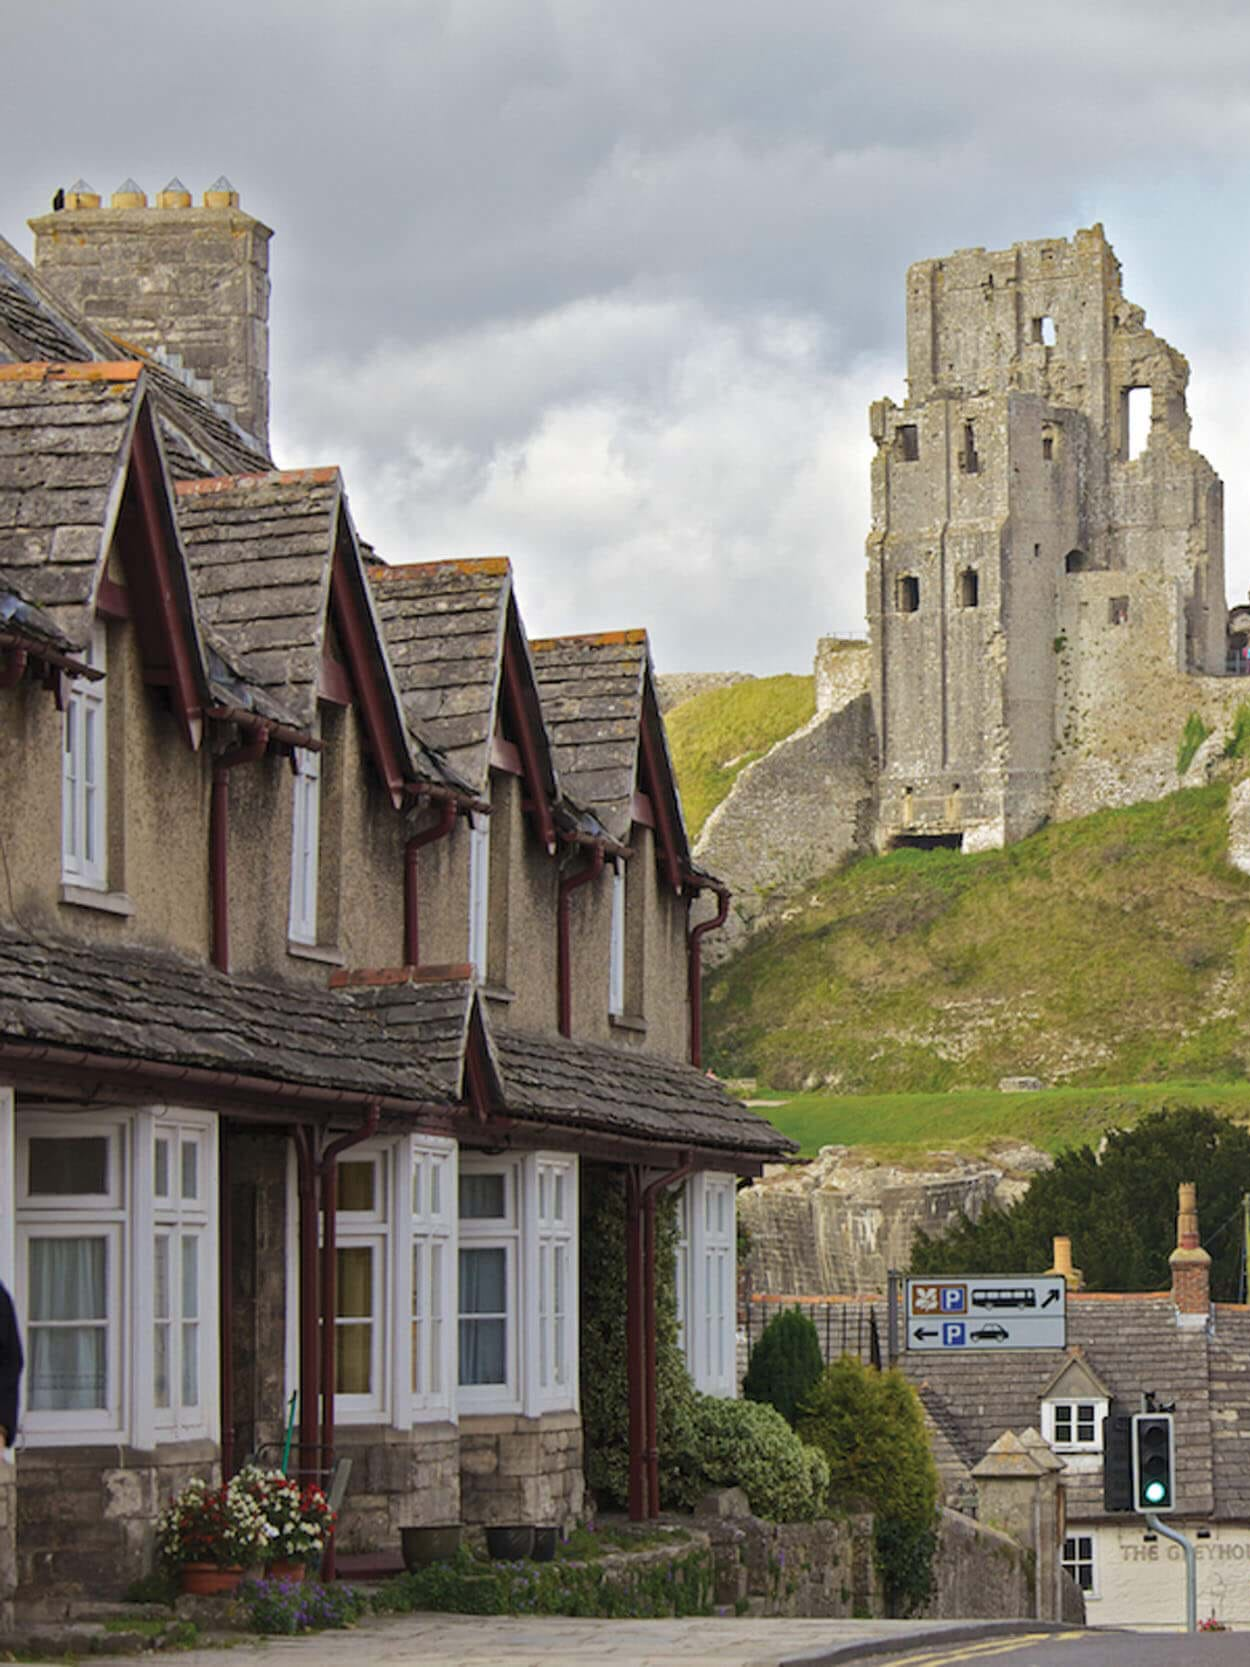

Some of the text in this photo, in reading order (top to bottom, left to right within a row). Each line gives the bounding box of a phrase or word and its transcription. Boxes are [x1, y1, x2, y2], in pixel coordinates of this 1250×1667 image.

[946, 1290, 961, 1310] P
[949, 1325, 961, 1344] P
[1119, 1544, 1159, 1561] THE
